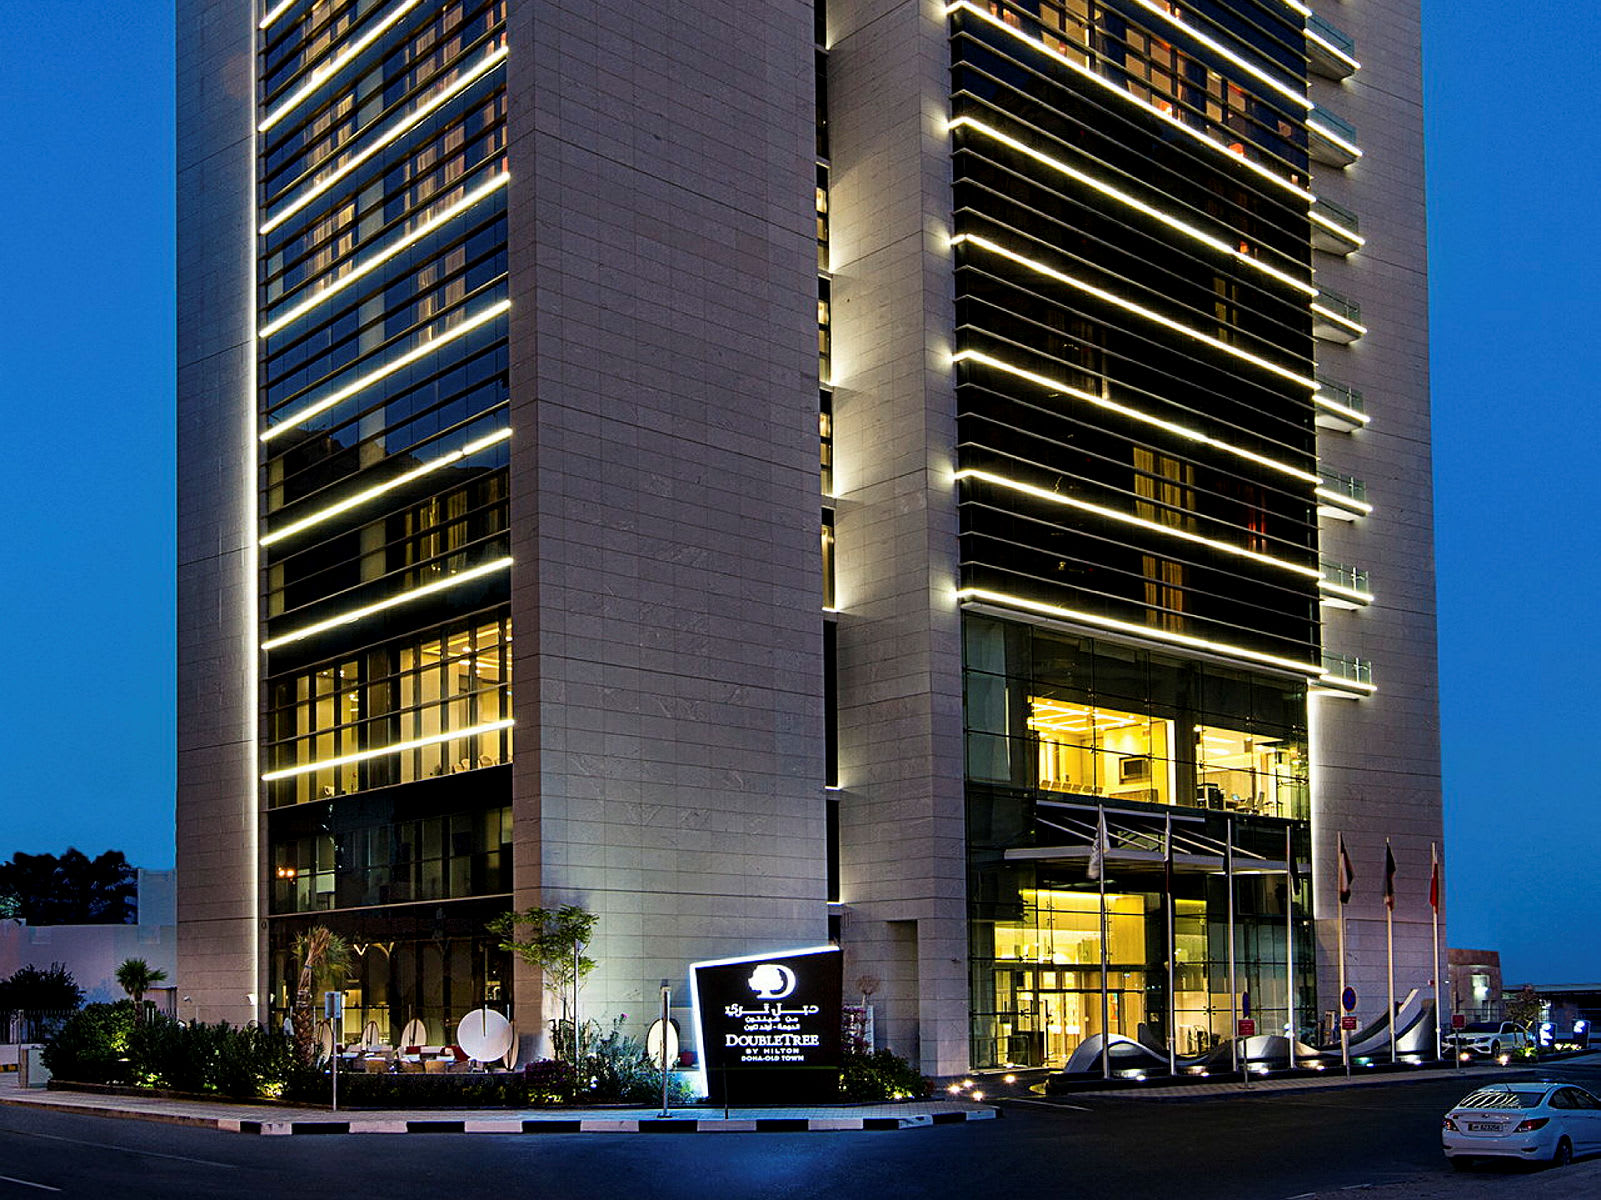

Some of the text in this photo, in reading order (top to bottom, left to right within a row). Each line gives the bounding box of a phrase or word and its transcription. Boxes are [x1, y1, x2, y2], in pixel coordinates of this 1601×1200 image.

[725, 1033, 820, 1047] DOUBLETREE
[745, 1047, 800, 1055] BY HILTON
